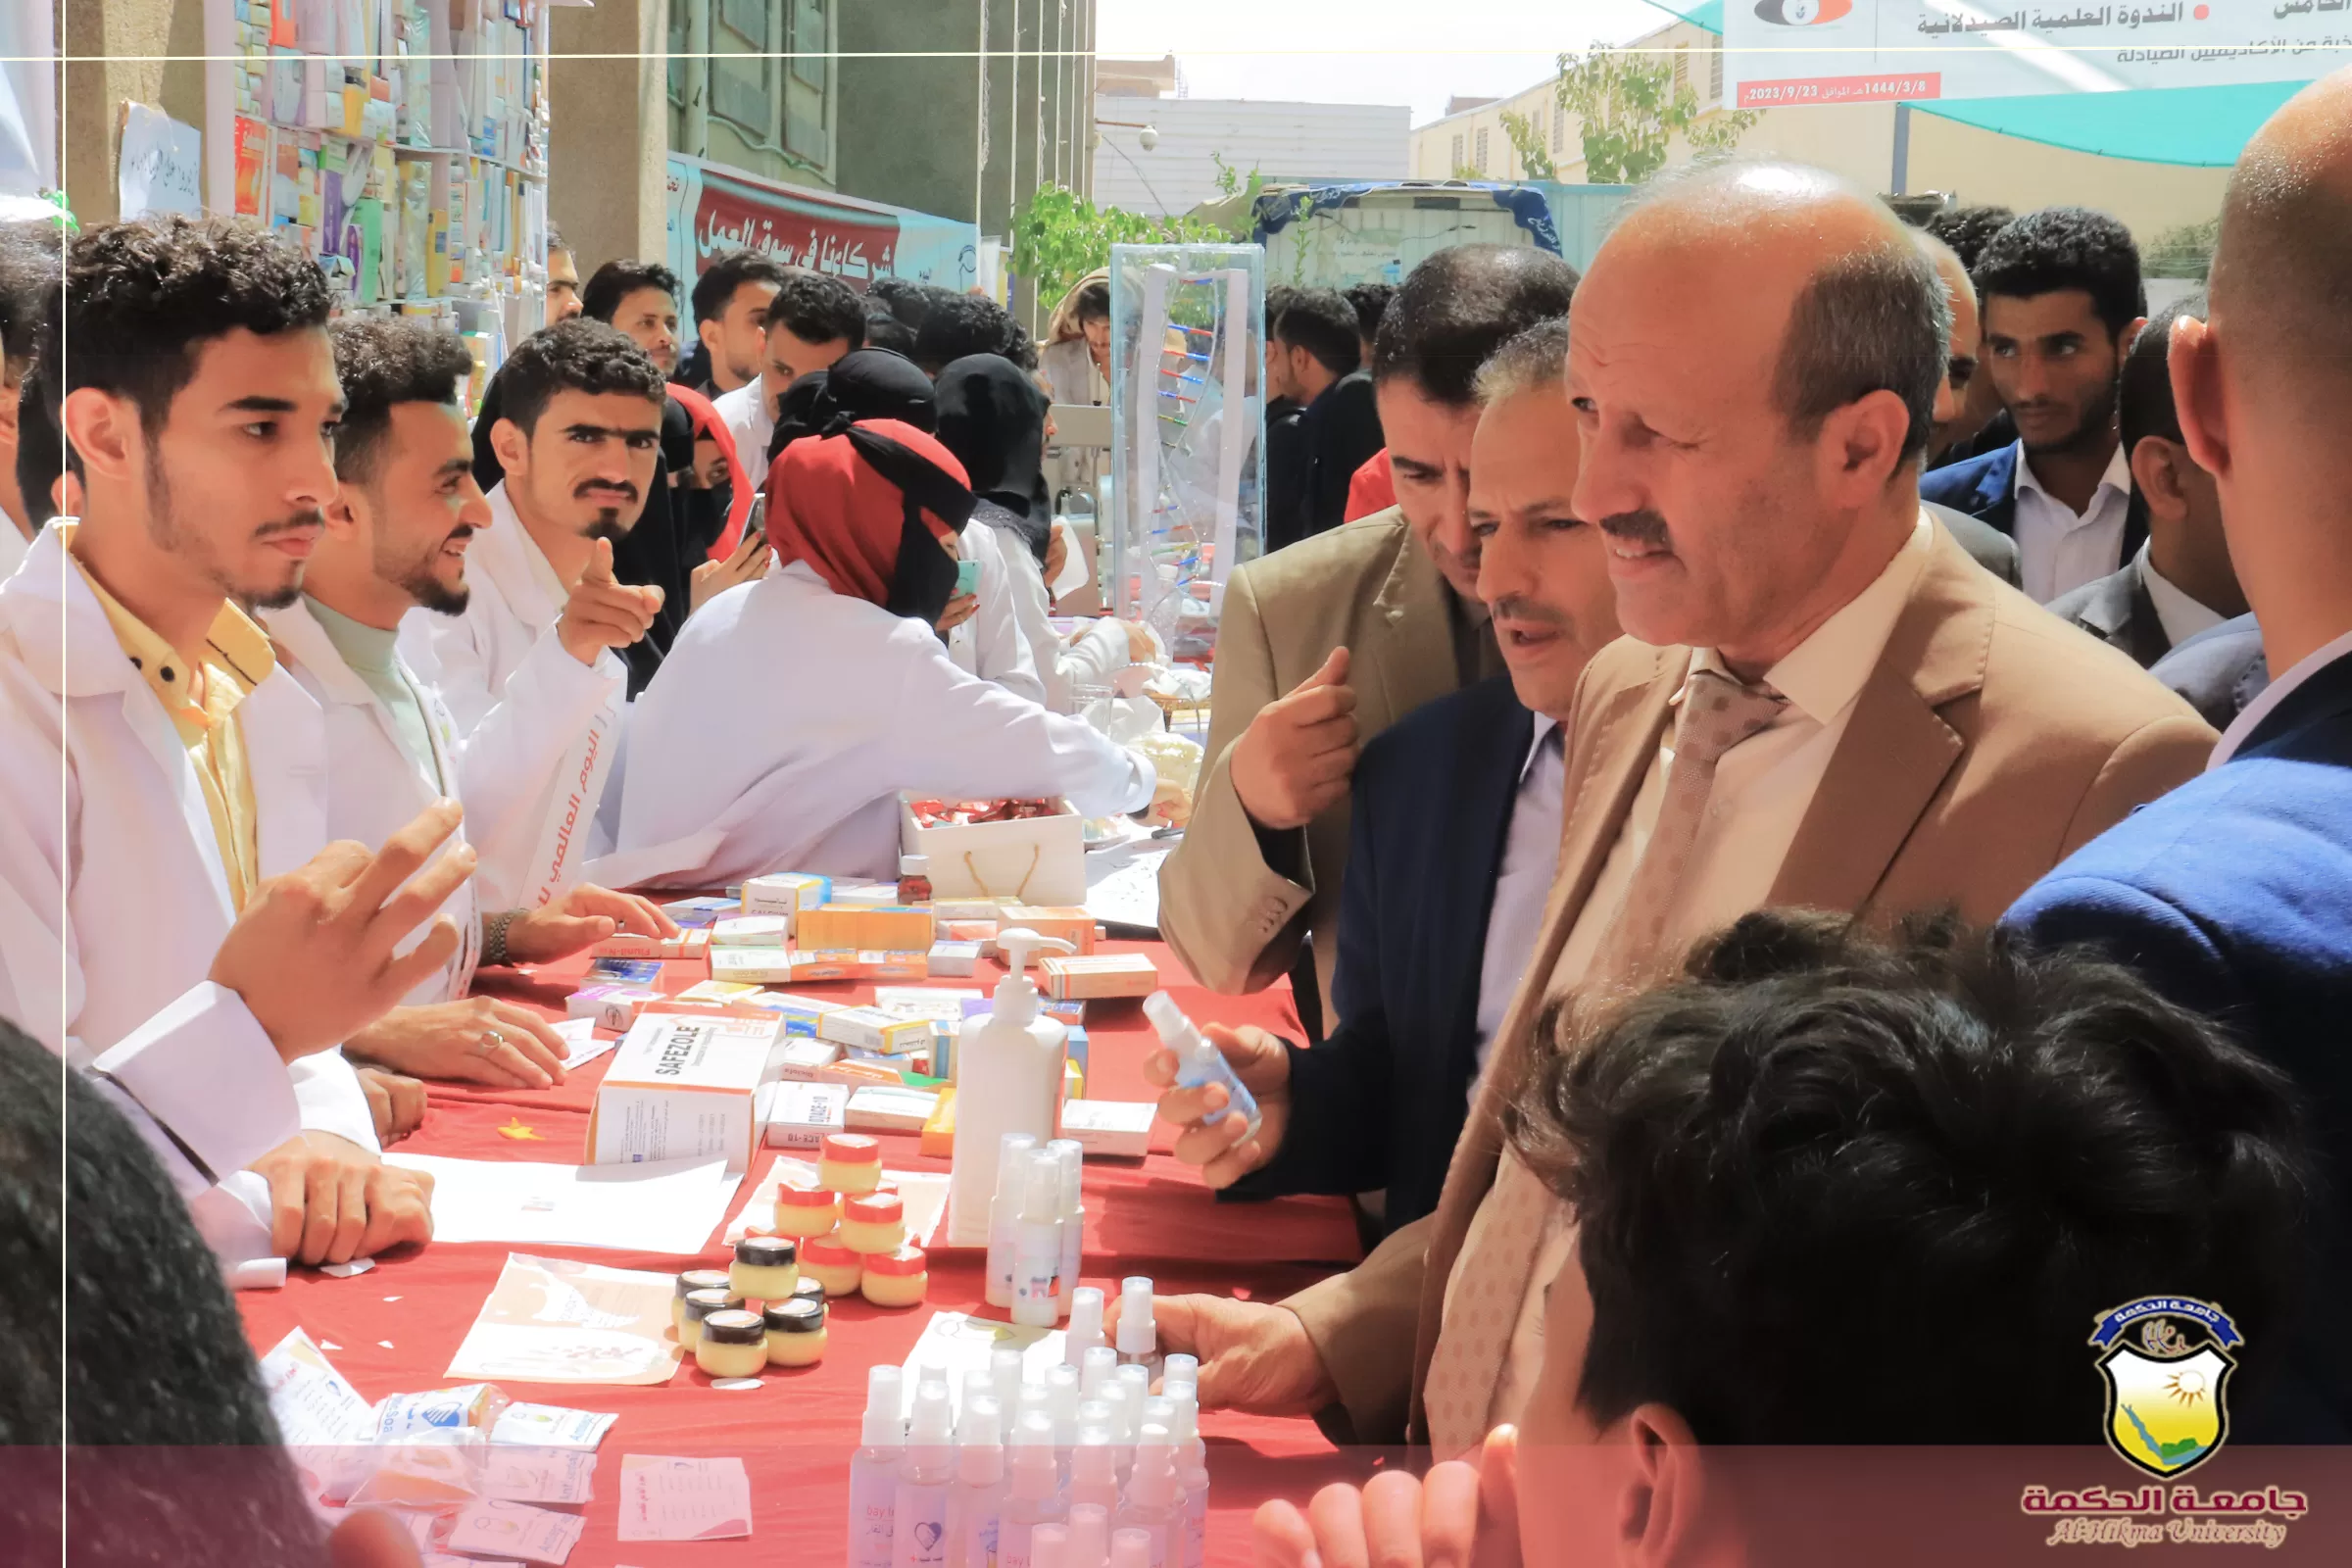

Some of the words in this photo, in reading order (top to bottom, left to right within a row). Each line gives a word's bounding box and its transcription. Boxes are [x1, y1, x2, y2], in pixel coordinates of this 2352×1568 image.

[1917, 11, 2027, 39] الصيدلانية
[2032, 5, 2111, 31] العلمية
[2118, 2, 2183, 27] الندوة
[699, 209, 757, 259] العمل
[579, 728, 601, 795] اليوم
[550, 793, 581, 883] العلمي
[655, 1026, 701, 1076] SAFEZOLE
